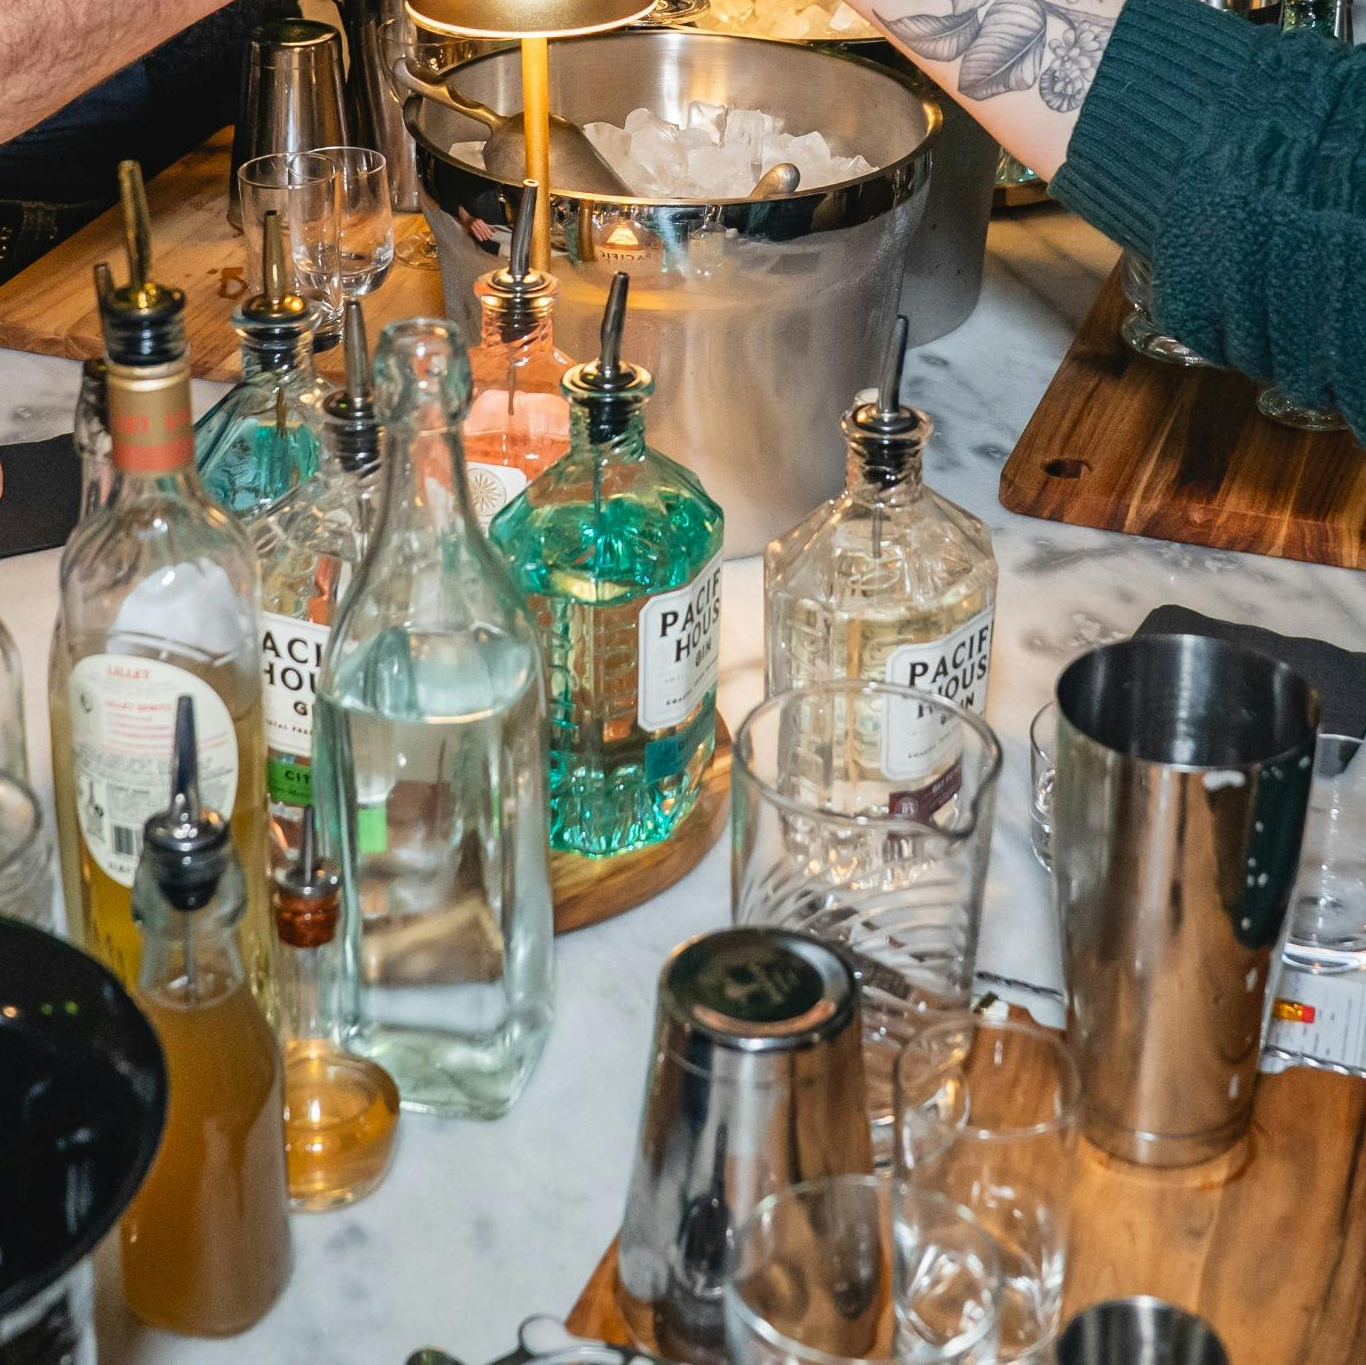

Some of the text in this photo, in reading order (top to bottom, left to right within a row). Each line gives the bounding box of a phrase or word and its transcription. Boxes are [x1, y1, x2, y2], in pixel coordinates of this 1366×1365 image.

[659, 567, 721, 638] PACIF
[674, 597, 720, 663] HOUS
[908, 625, 989, 688] PACIF
